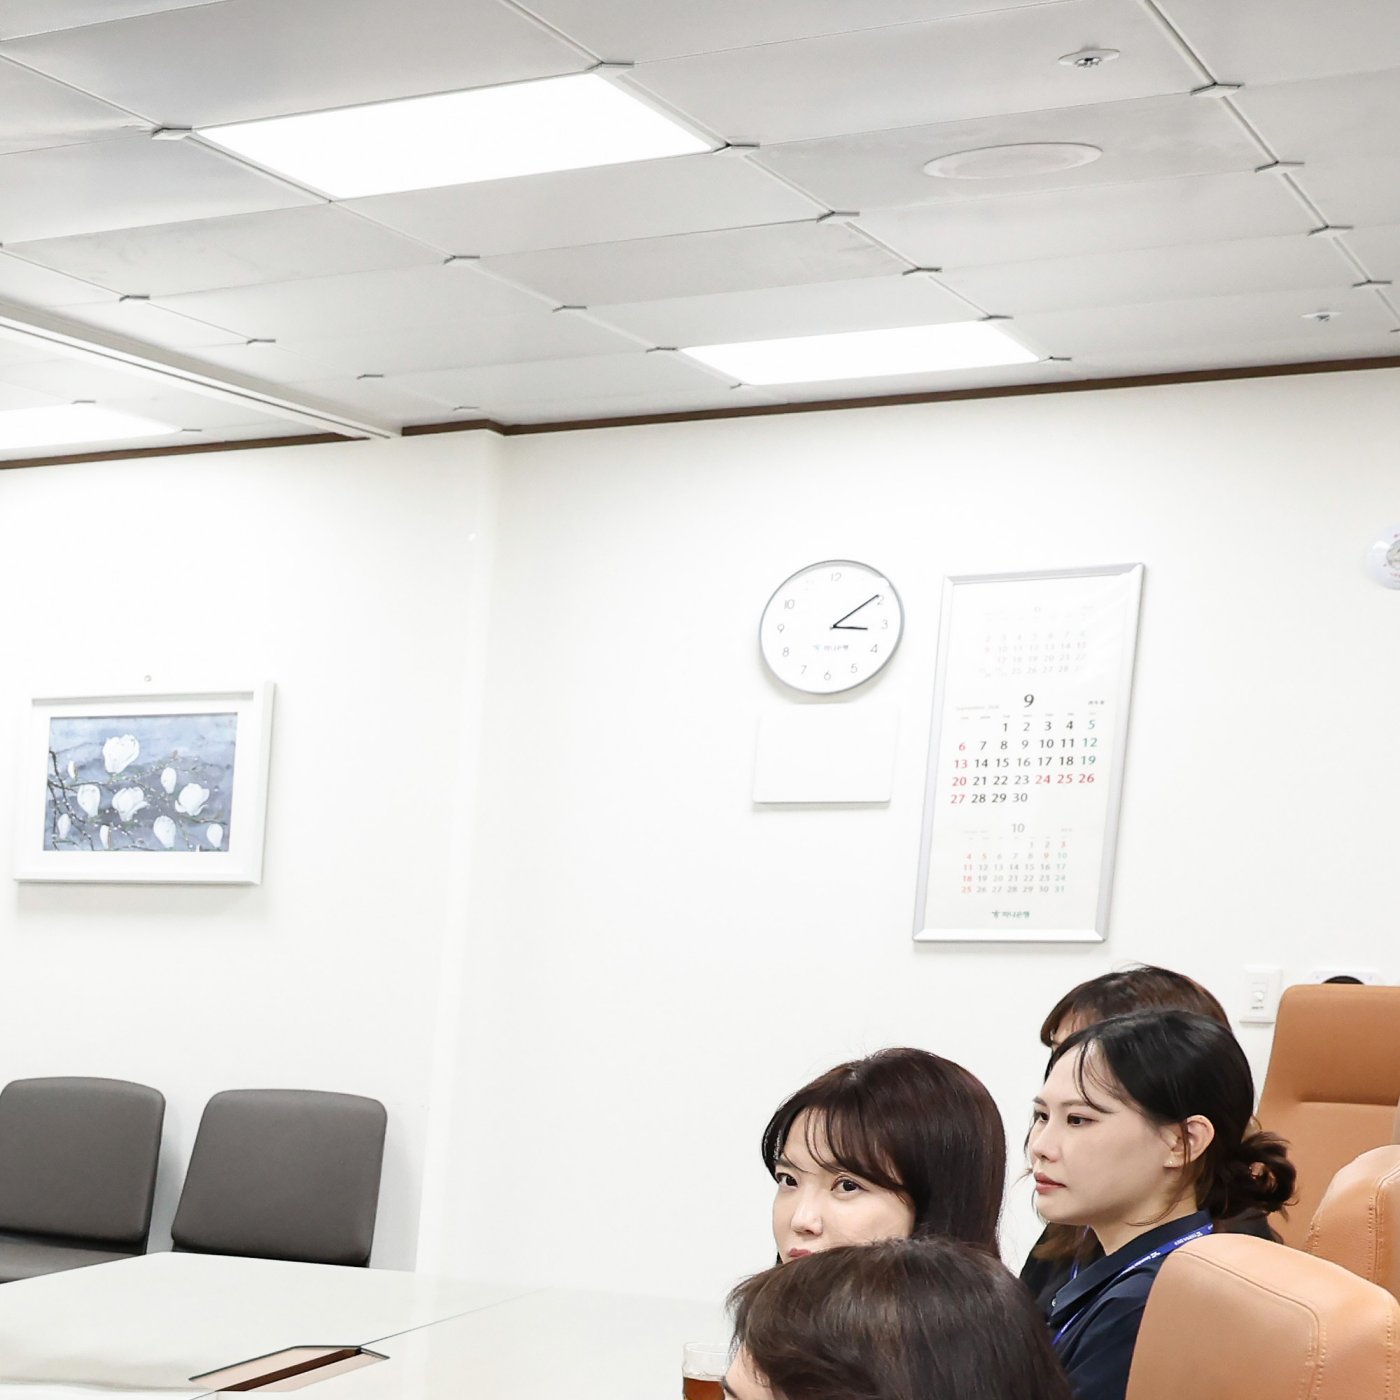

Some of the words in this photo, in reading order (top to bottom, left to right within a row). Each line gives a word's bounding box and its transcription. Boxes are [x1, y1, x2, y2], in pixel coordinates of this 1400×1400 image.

[830, 572, 843, 582] 12
[783, 599, 796, 610] 10
[776, 624, 785, 633] 9
[881, 619, 889, 630] 3
[782, 646, 790, 658] 8
[869, 643, 879, 654] 4
[800, 664, 808, 675] 7
[850, 663, 859, 674] 5
[823, 671, 832, 681] 6
[1023, 694, 1035, 708] 9
[1003, 722, 1008, 732] 1
[1023, 721, 1031, 732] 2
[1045, 720, 1052, 731] 3
[1066, 720, 1073, 730] 4
[1088, 719, 1096, 730] 5
[958, 742, 966, 751] 6
[980, 740, 987, 751] 7
[1000, 740, 1008, 750] 8
[1021, 739, 1029, 749] 9
[1040, 739, 1055, 749] 10
[1061, 738, 1075, 748] 11
[1083, 737, 1098, 748] 12
[955, 759, 968, 769] 13
[975, 758, 988, 768] 14
[996, 758, 1009, 768] 15
[1017, 757, 1031, 767] 16
[1038, 756, 1053, 767] 17
[1060, 756, 1074, 766] 18
[1082, 755, 1097, 765] 19
[952, 776, 967, 787] 20
[972, 776, 987, 786] 21
[993, 775, 1008, 786] 22
[1014, 774, 1030, 785] 23
[1035, 774, 1051, 785] 24
[1056, 773, 1073, 784] 25
[1078, 773, 1095, 784] 26
[950, 793, 966, 804] 27
[971, 793, 987, 804] 28
[991, 793, 1007, 803] 29
[1014, 792, 1028, 803] 30
[1012, 822, 1026, 833] 10
